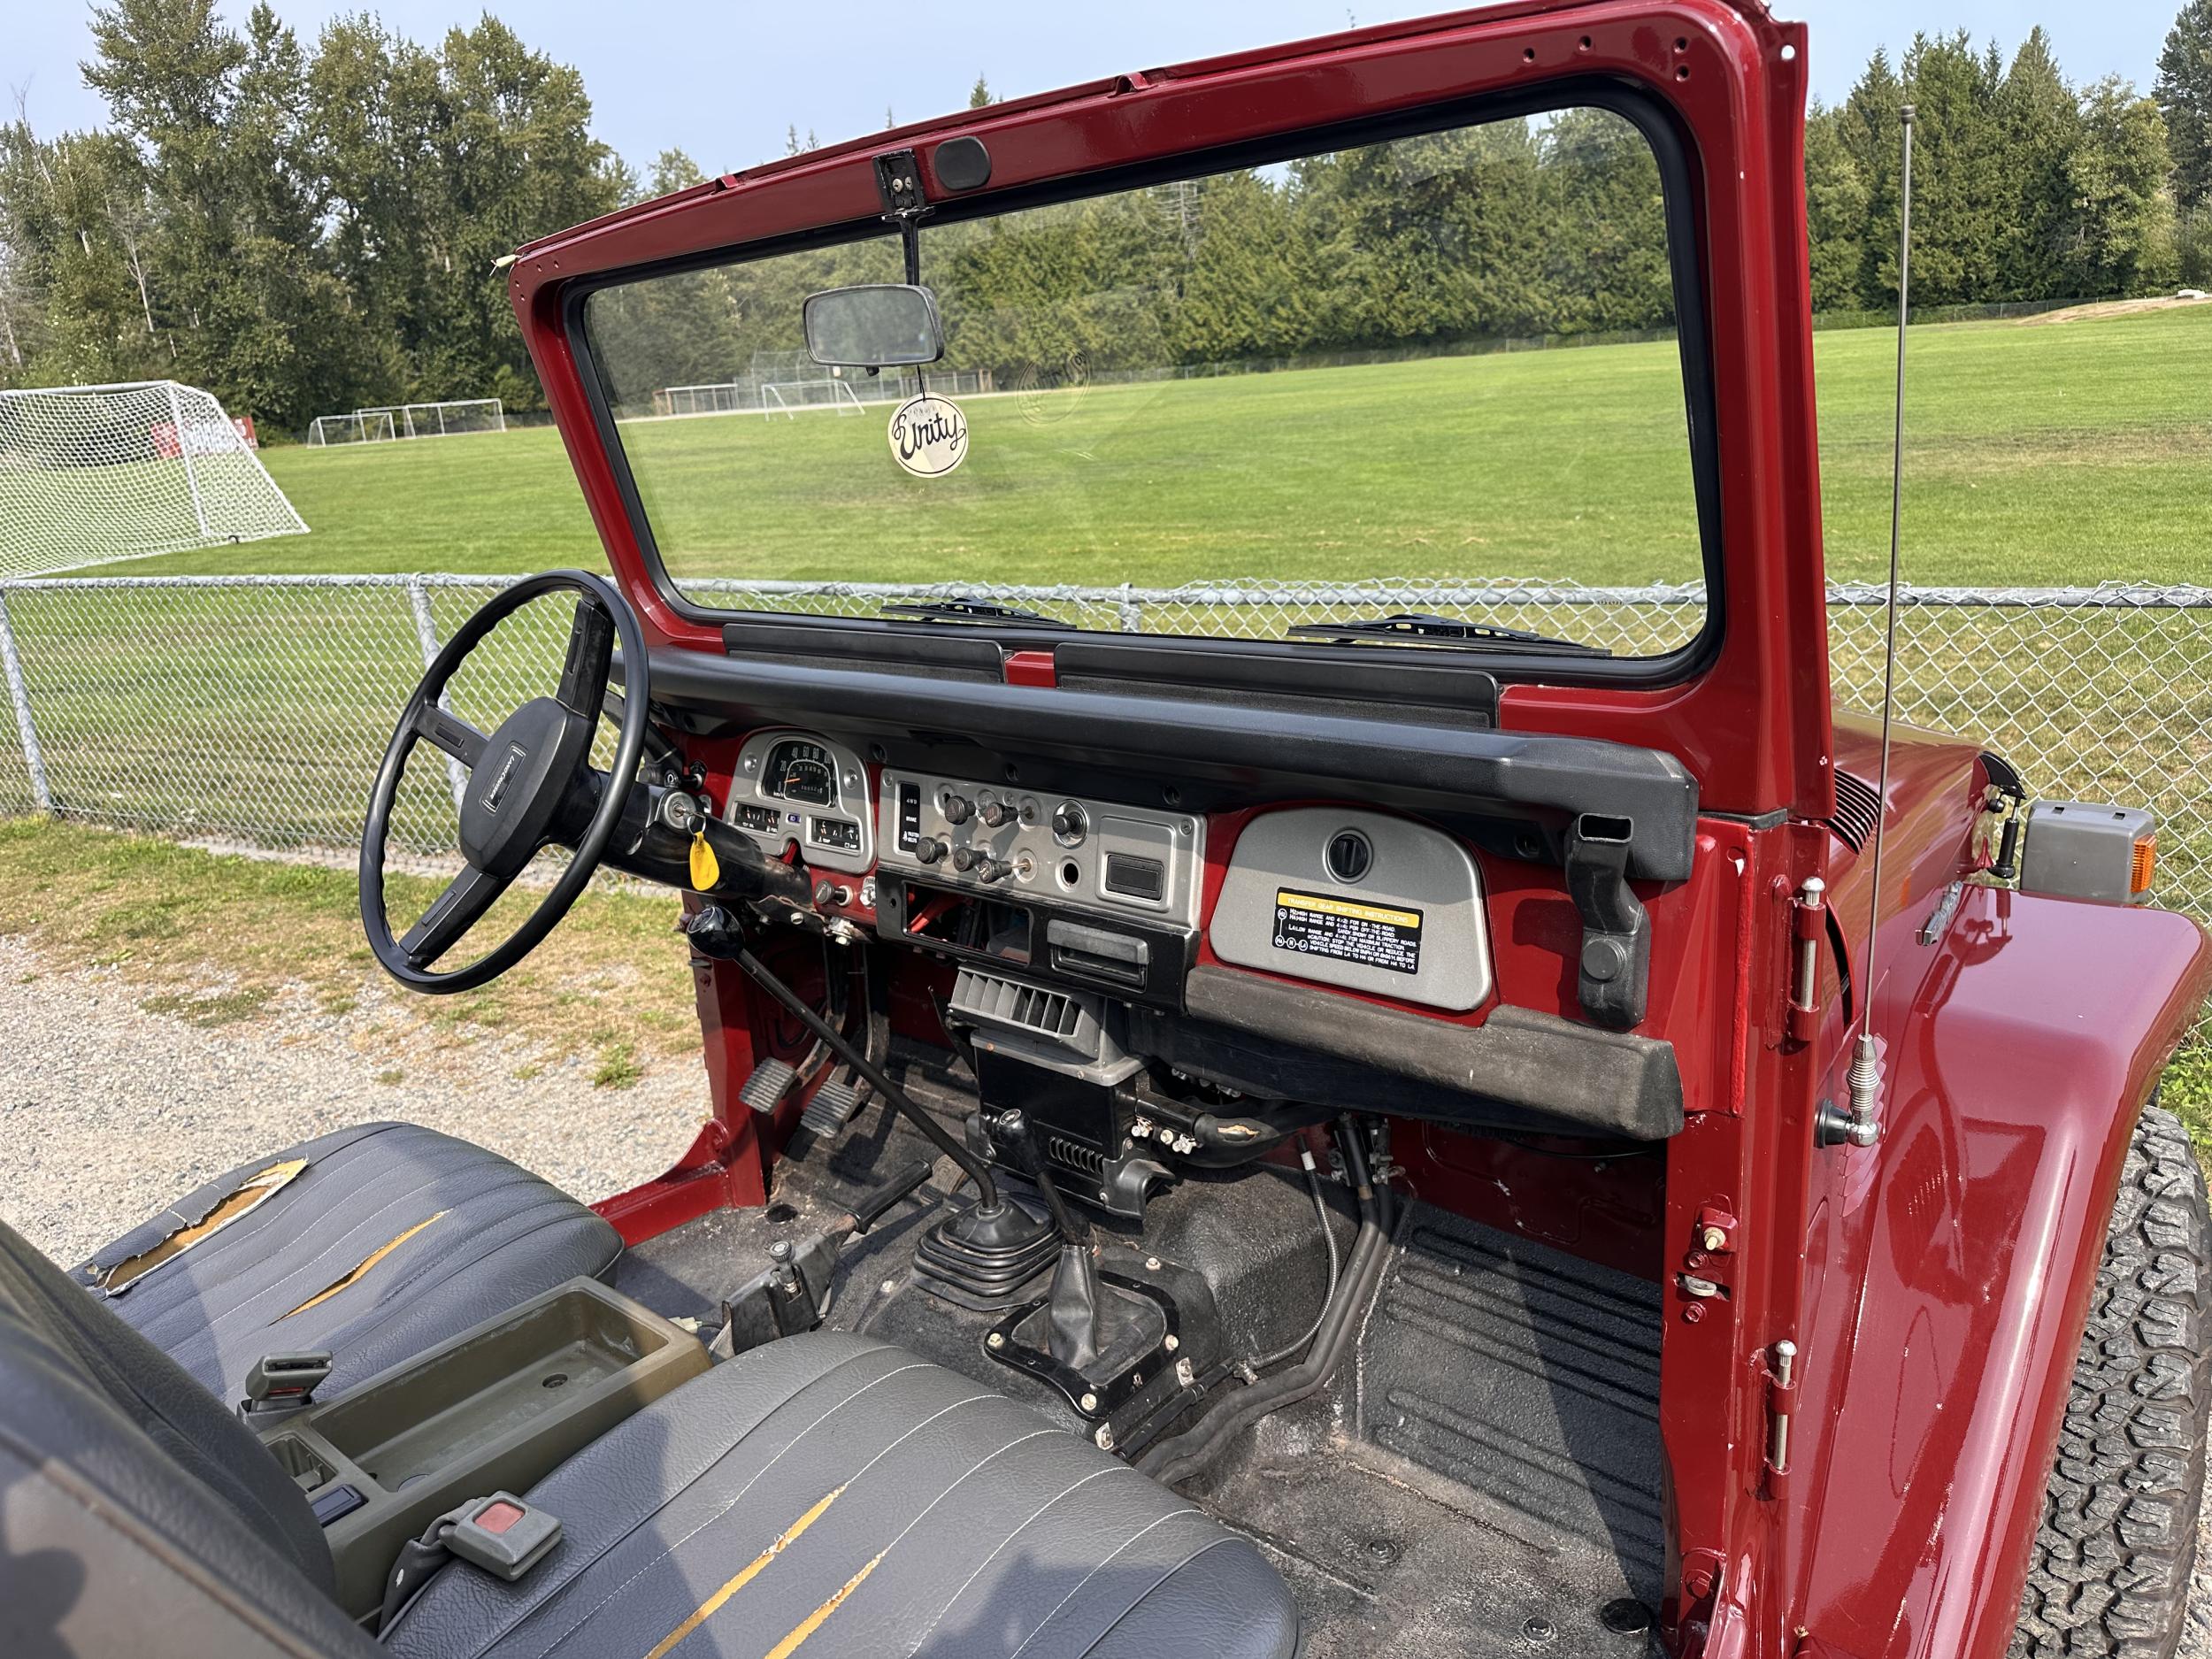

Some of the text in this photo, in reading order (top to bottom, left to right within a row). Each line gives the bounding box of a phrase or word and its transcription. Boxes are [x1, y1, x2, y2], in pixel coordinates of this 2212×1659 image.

[894, 412, 966, 460] Unity
[791, 747, 799, 758] 40
[803, 746, 810, 758] 60
[780, 759, 787, 772] 20
[1287, 898, 1316, 907] TRANSFER
[1336, 906, 1363, 915] SHIFTING
[1365, 910, 1409, 922] INSTRUCTIONS
